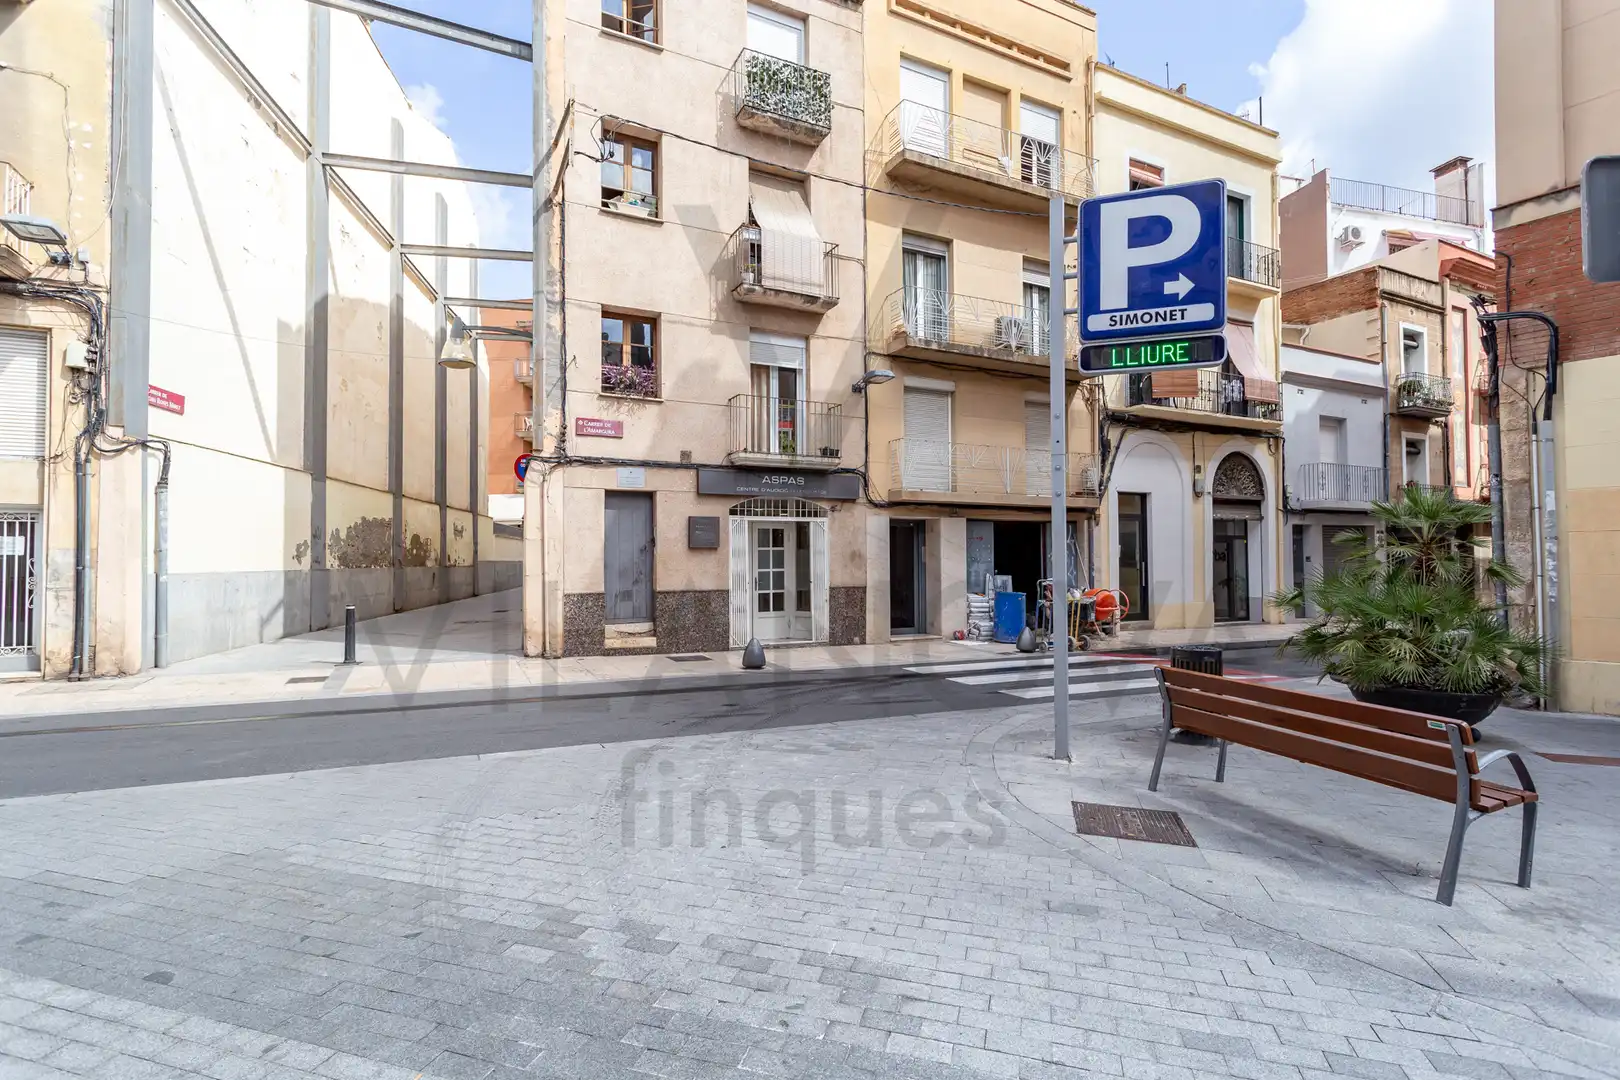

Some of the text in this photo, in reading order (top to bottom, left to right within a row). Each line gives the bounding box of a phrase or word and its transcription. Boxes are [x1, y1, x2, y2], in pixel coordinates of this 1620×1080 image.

[1100, 194, 1202, 311] P
[1108, 308, 1188, 327] SIMONET
[1111, 342, 1190, 367] LLIURE
[761, 475, 805, 486] ASPAS
